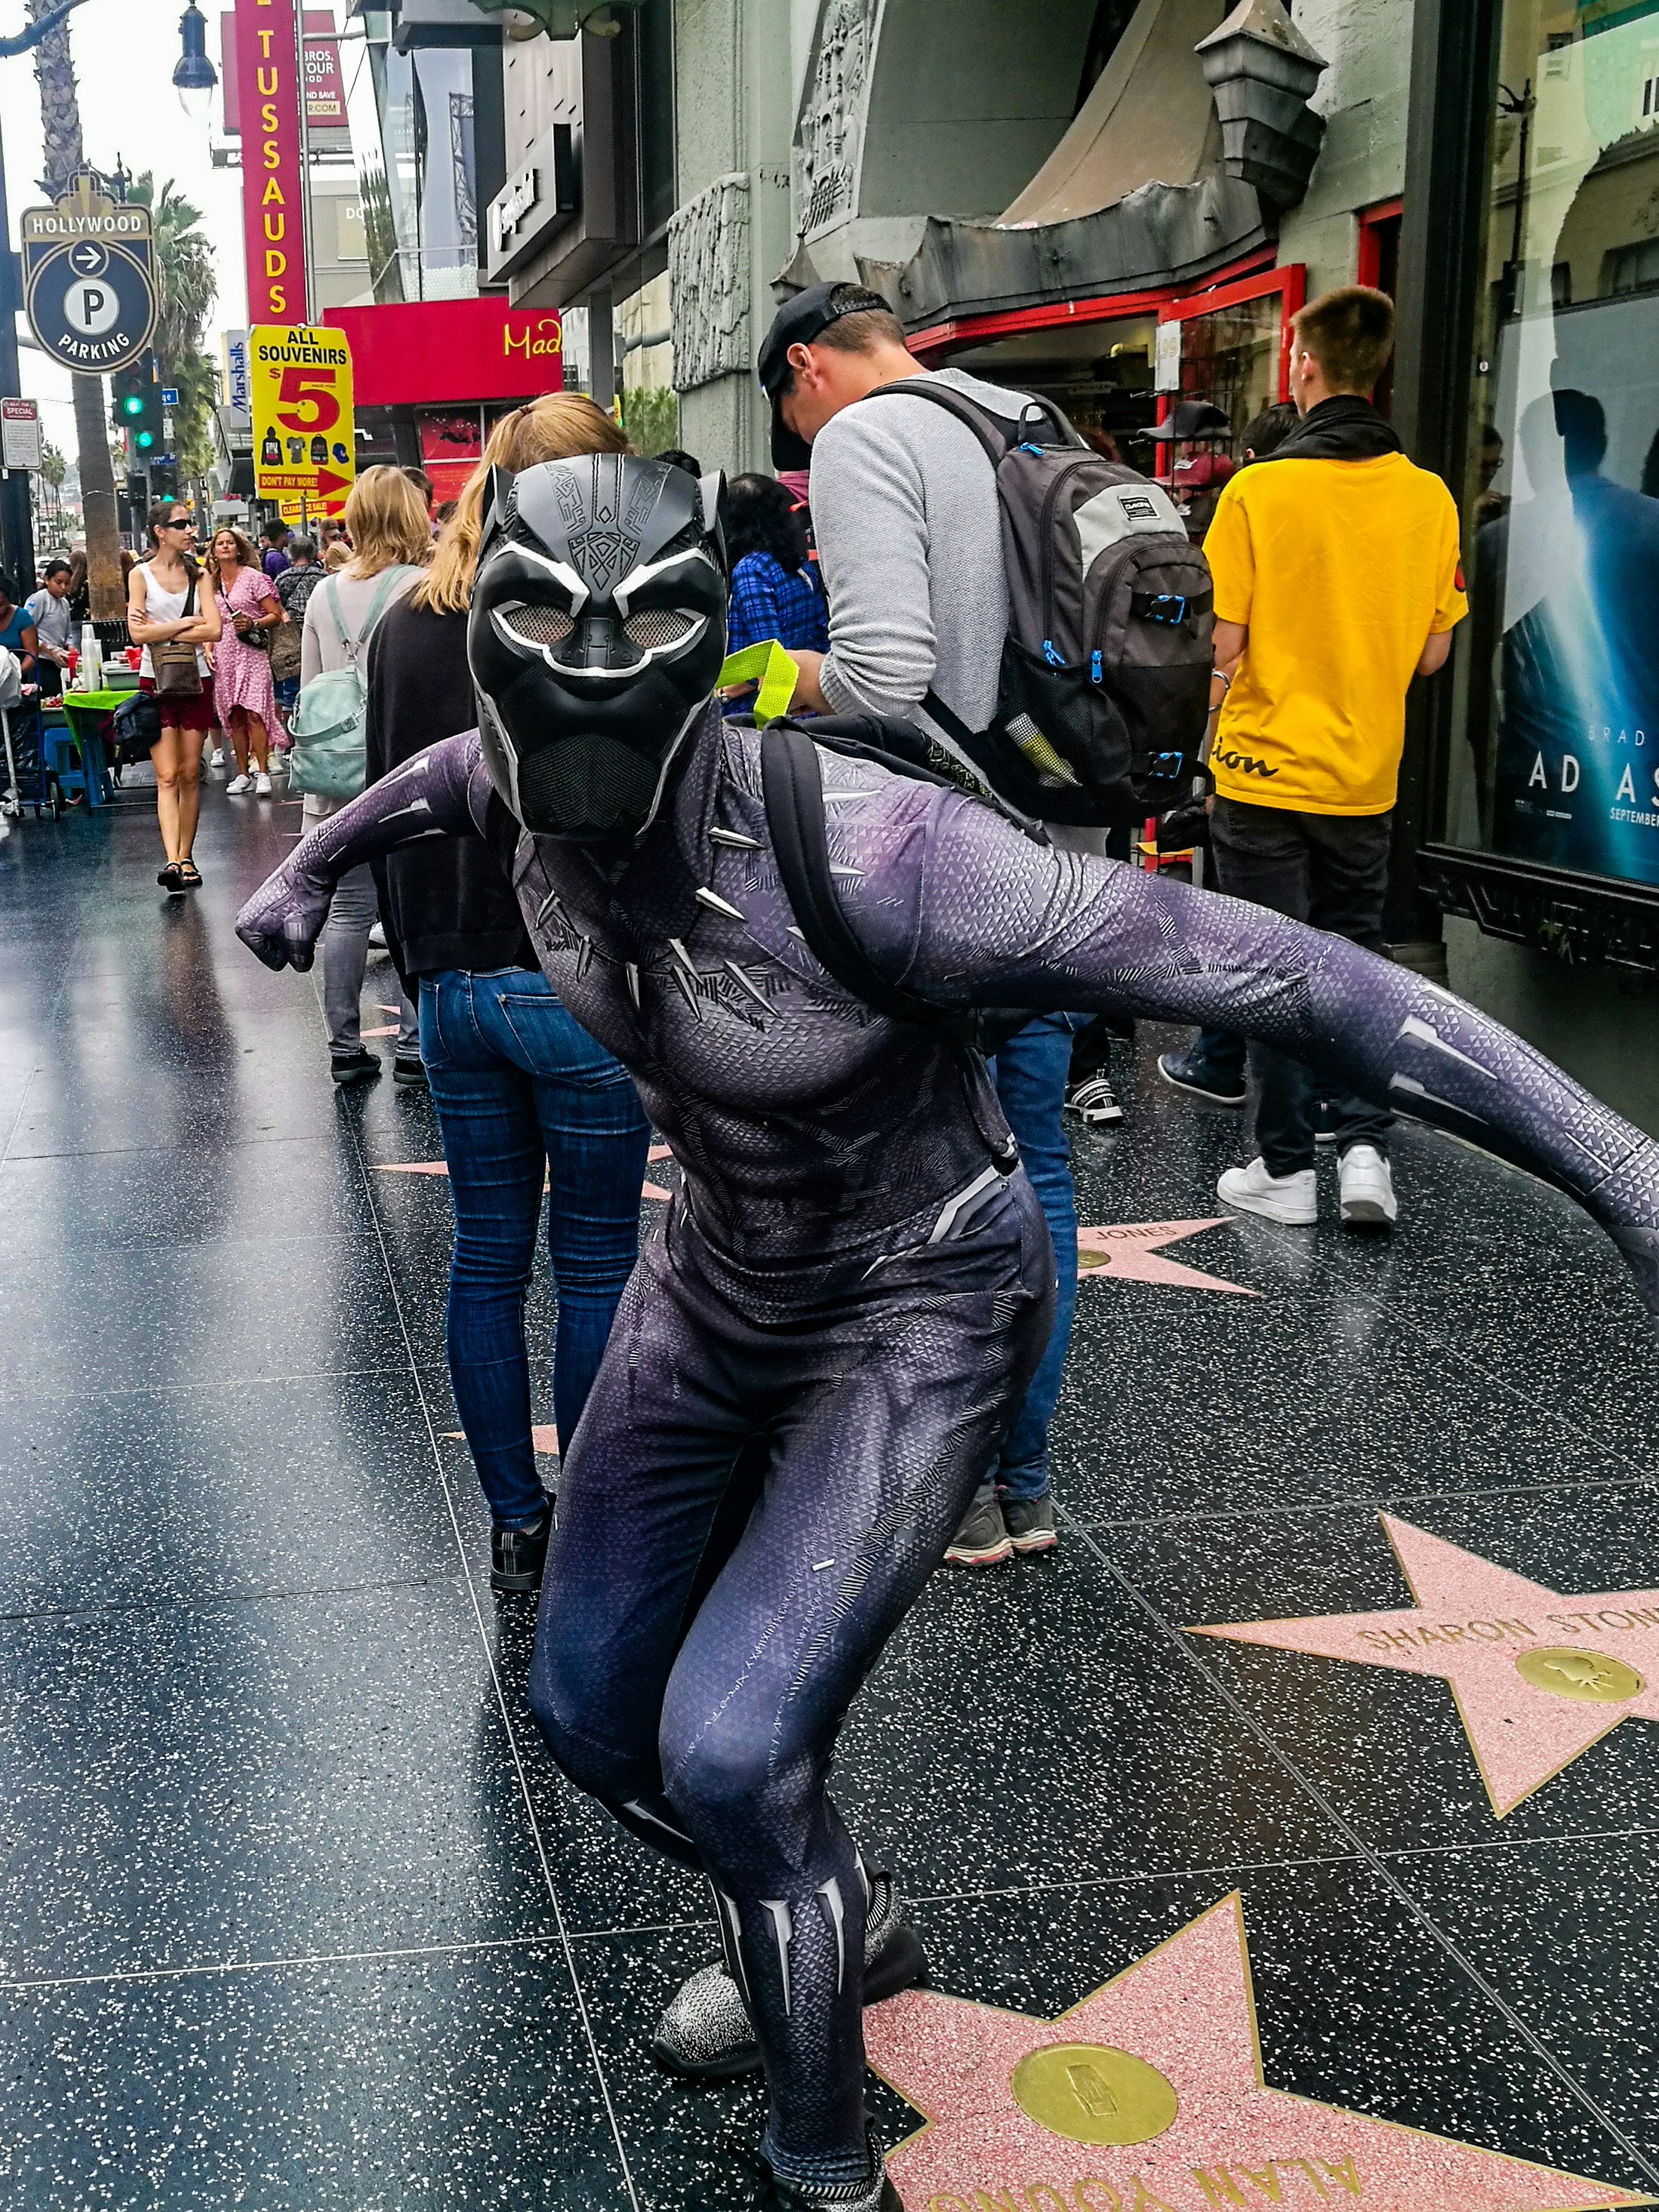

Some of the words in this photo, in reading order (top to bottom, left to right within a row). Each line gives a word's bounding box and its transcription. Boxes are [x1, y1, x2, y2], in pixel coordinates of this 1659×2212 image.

[305, 63, 334, 74] OUR
[257, 29, 287, 314] TUSSAUDS
[33, 216, 142, 234] HOLLYWOOD
[83, 289, 105, 325] P
[58, 332, 131, 360] PARKING
[288, 331, 319, 345] ALL
[259, 345, 346, 365] SOUVENIRS
[229, 342, 247, 413] Marshalls
[261, 477, 282, 486] DON'T
[283, 477, 297, 487] PAY
[283, 504, 312, 515] CLEARCE
[1589, 725, 1645, 746] BRAD
[1528, 750, 1581, 792] AD
[1097, 1226, 1177, 1241] JONES
[1359, 1618, 1537, 1650] SHARON
[1547, 1606, 1659, 1633] STON
[1193, 2155, 1361, 2210] ALAN
